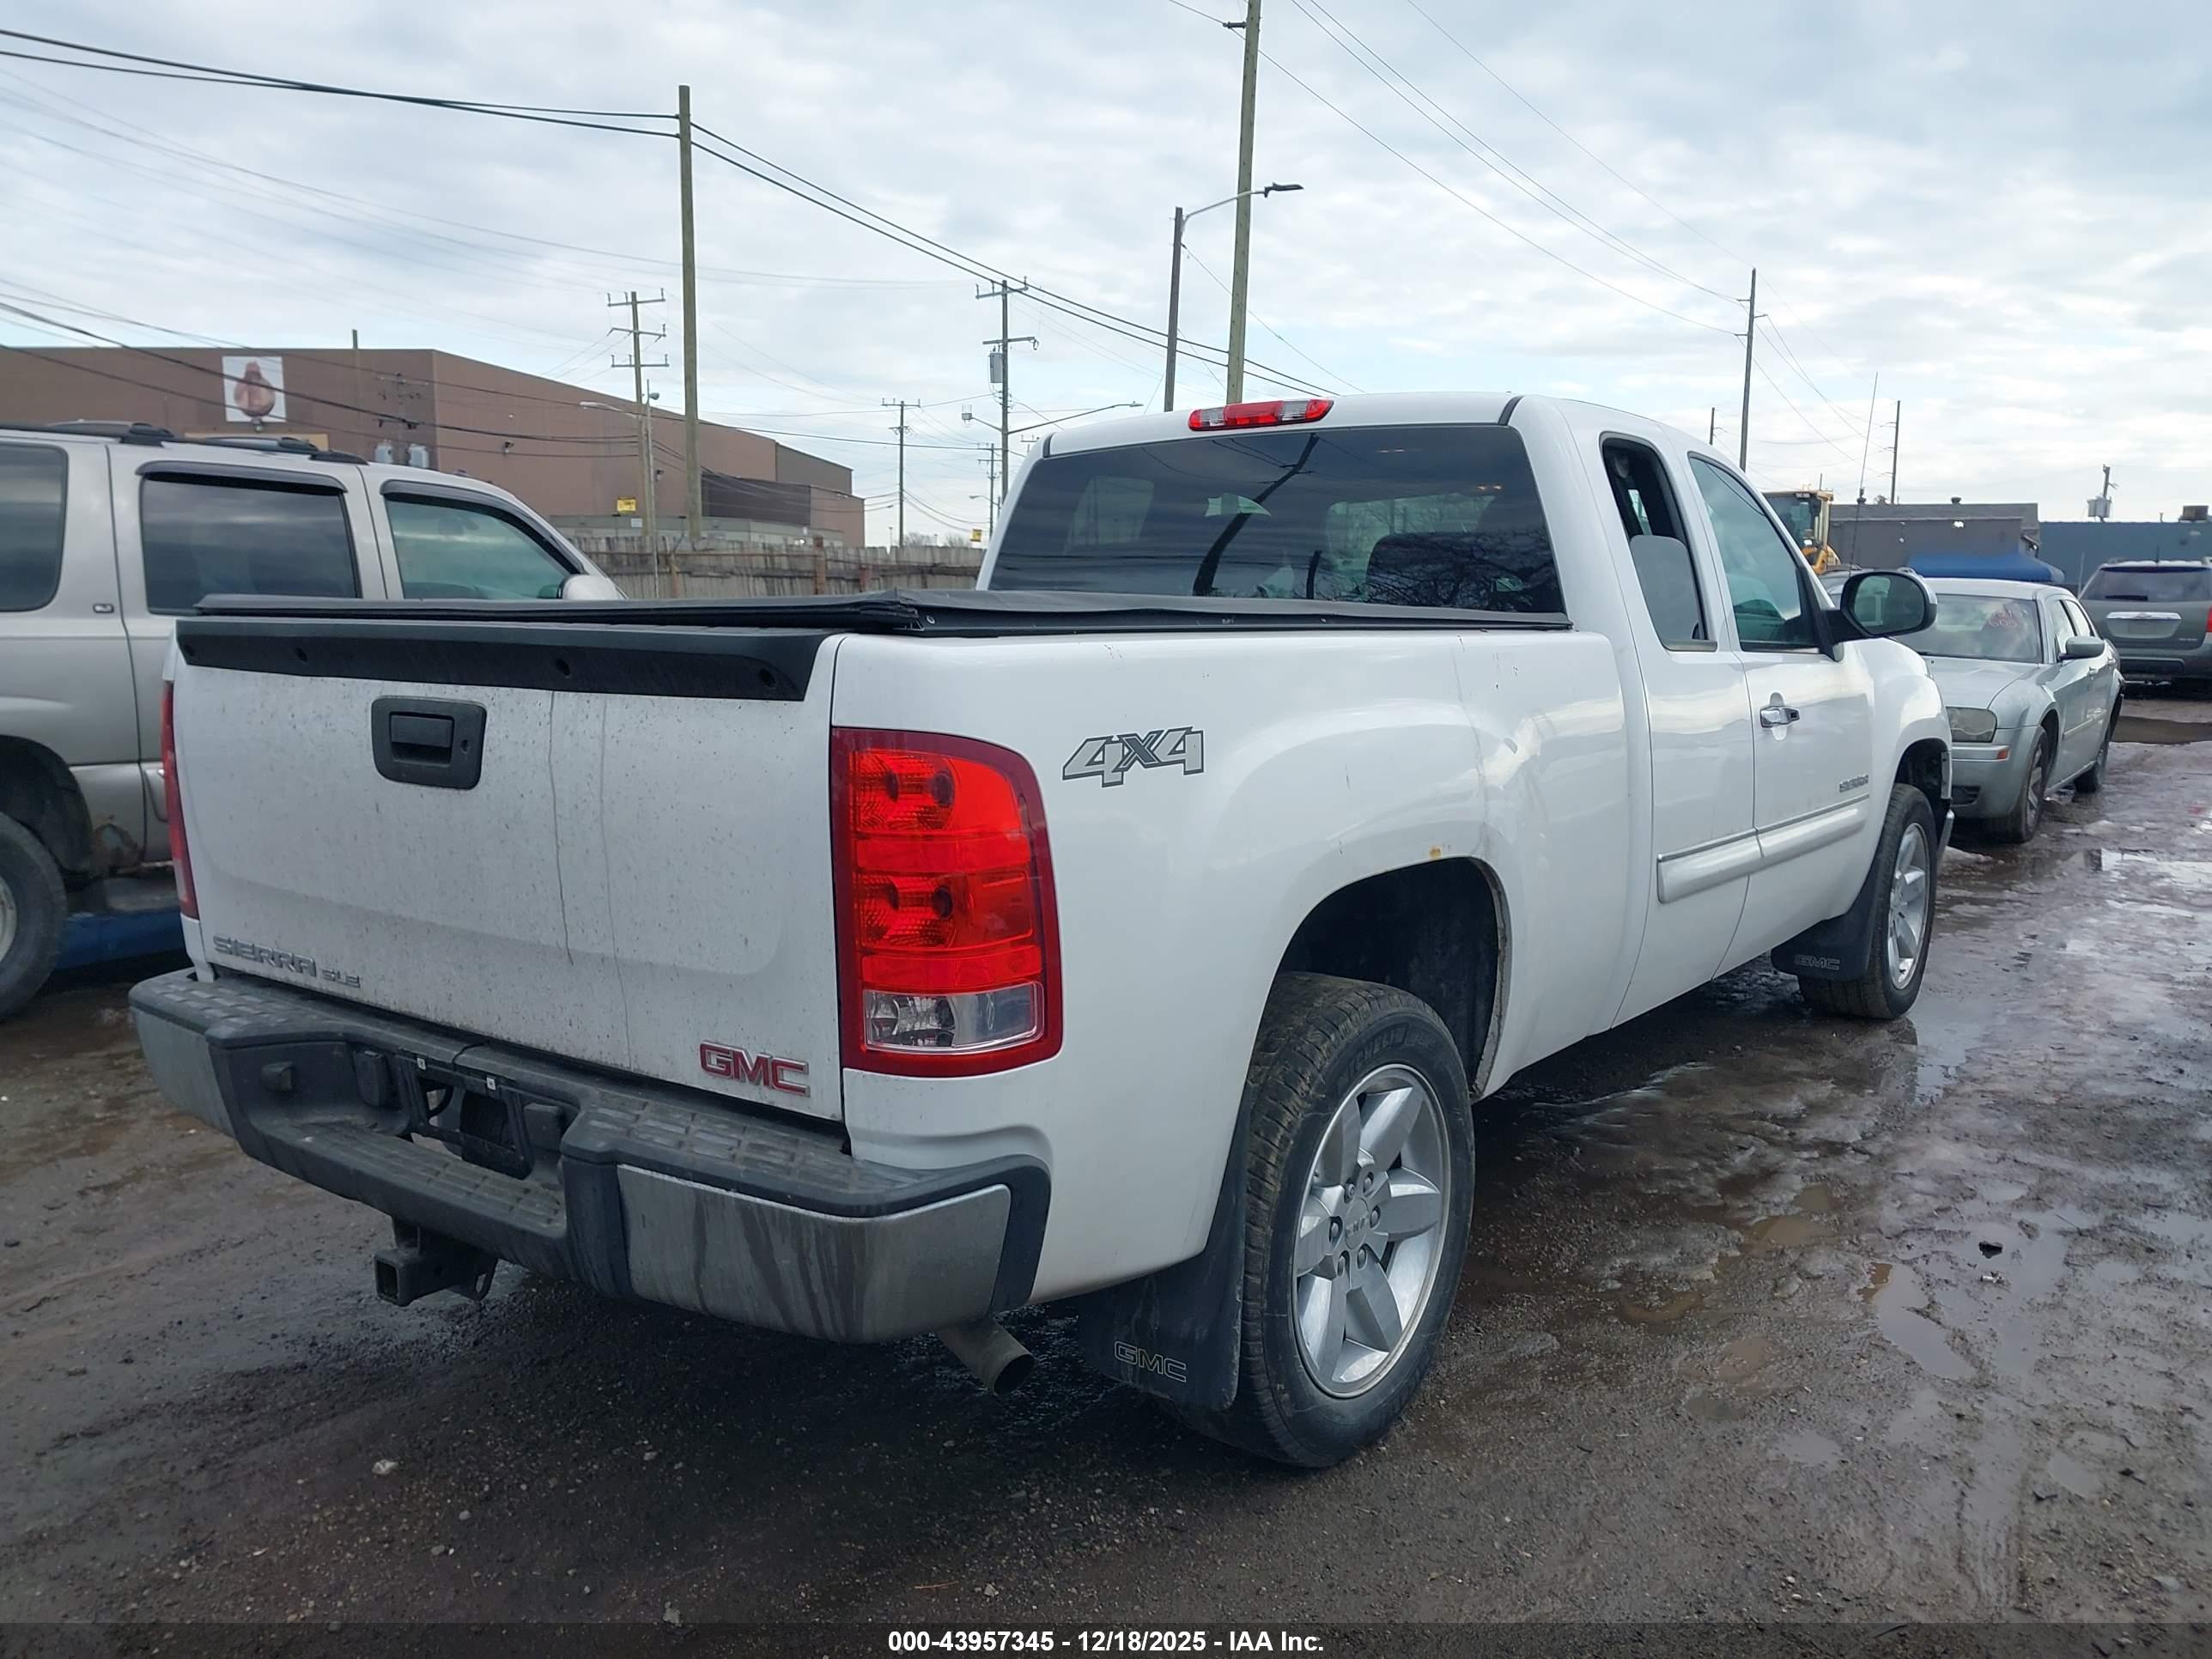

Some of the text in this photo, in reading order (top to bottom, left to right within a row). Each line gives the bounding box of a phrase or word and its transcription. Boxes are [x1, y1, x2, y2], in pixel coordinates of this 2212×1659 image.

[213, 935, 362, 988] SIERRA SLE
[1794, 954, 1841, 970] GMC
[700, 1040, 811, 1098] GMC
[1115, 1340, 1187, 1382] GMC
